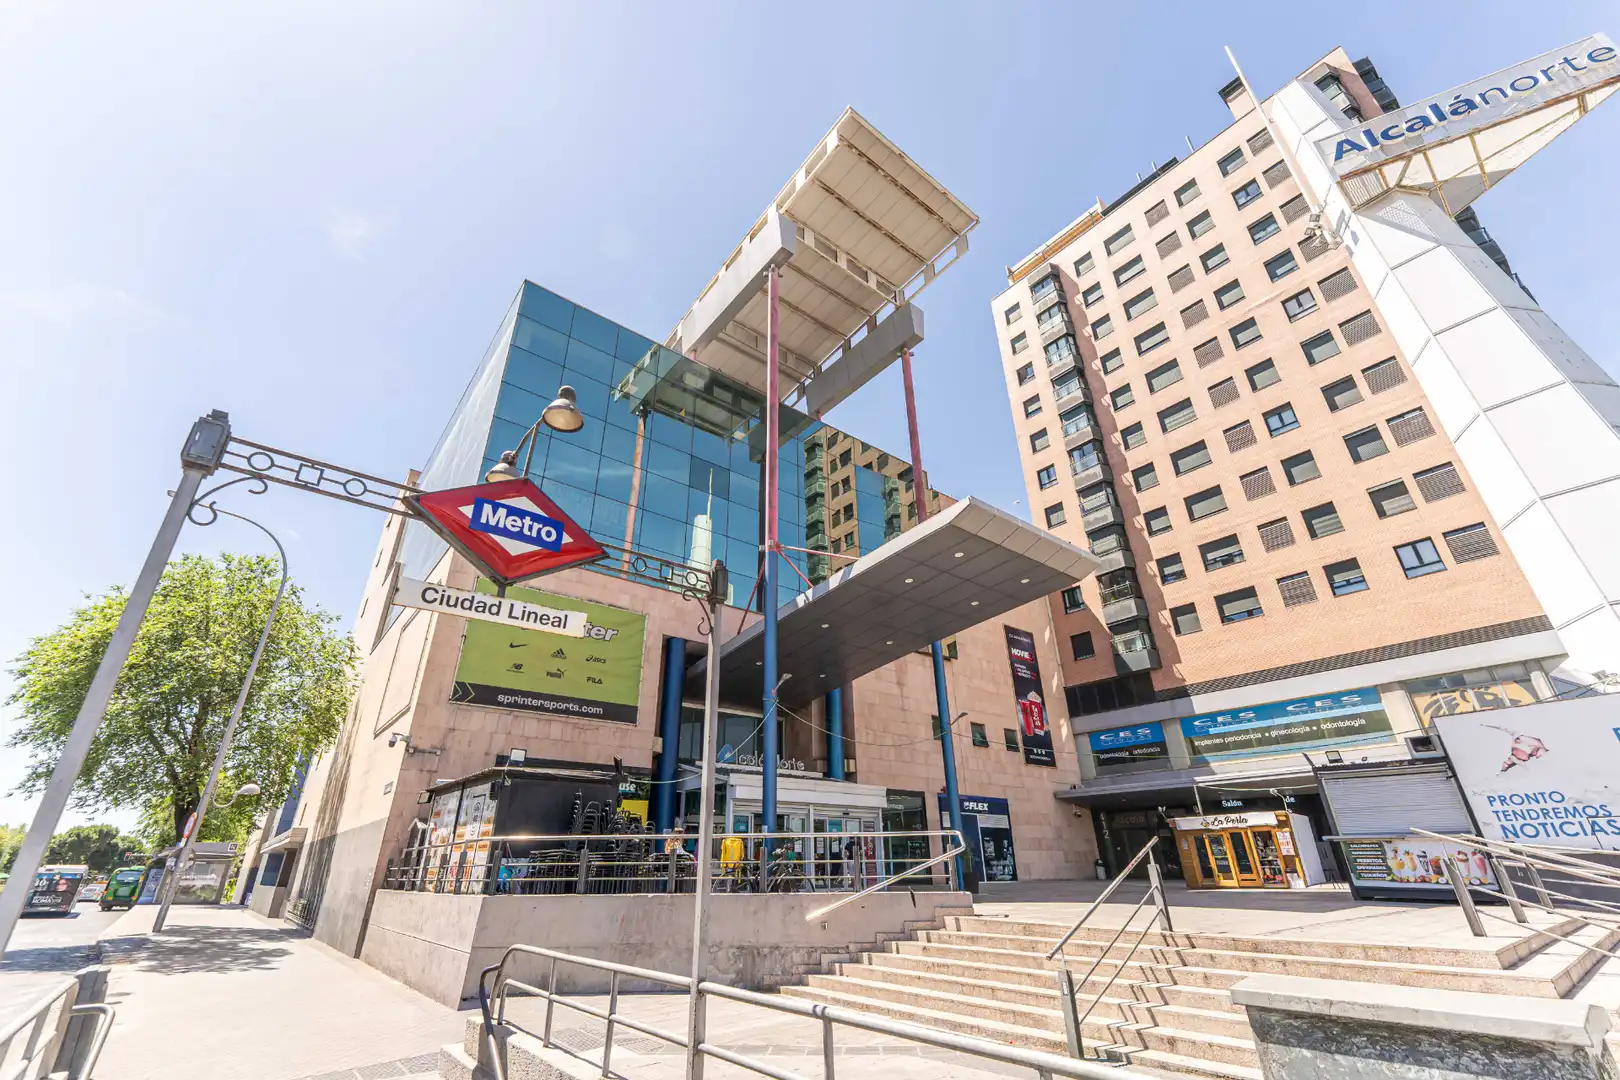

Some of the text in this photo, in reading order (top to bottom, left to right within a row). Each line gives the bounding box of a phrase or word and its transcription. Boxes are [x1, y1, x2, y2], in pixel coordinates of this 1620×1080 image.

[1333, 46, 1618, 163] Alcalánorte
[480, 503, 557, 543] Metro
[421, 586, 568, 629] Ciudad Lineal
[583, 622, 619, 641] ter
[586, 676, 603, 685] FILA
[497, 692, 603, 715] sprintersports.com
[1286, 695, 1362, 712] CES
[1193, 711, 1256, 726] CES
[1320, 718, 1366, 730] odontología
[1100, 727, 1151, 740] CES
[969, 802, 988, 811] FLEX
[1222, 799, 1242, 808] Salón
[1487, 790, 1565, 807] PRONTO
[1211, 815, 1248, 827] La Perla
[1492, 804, 1612, 822] TENDREMOS
[1500, 819, 1620, 839] NOTICIAS
